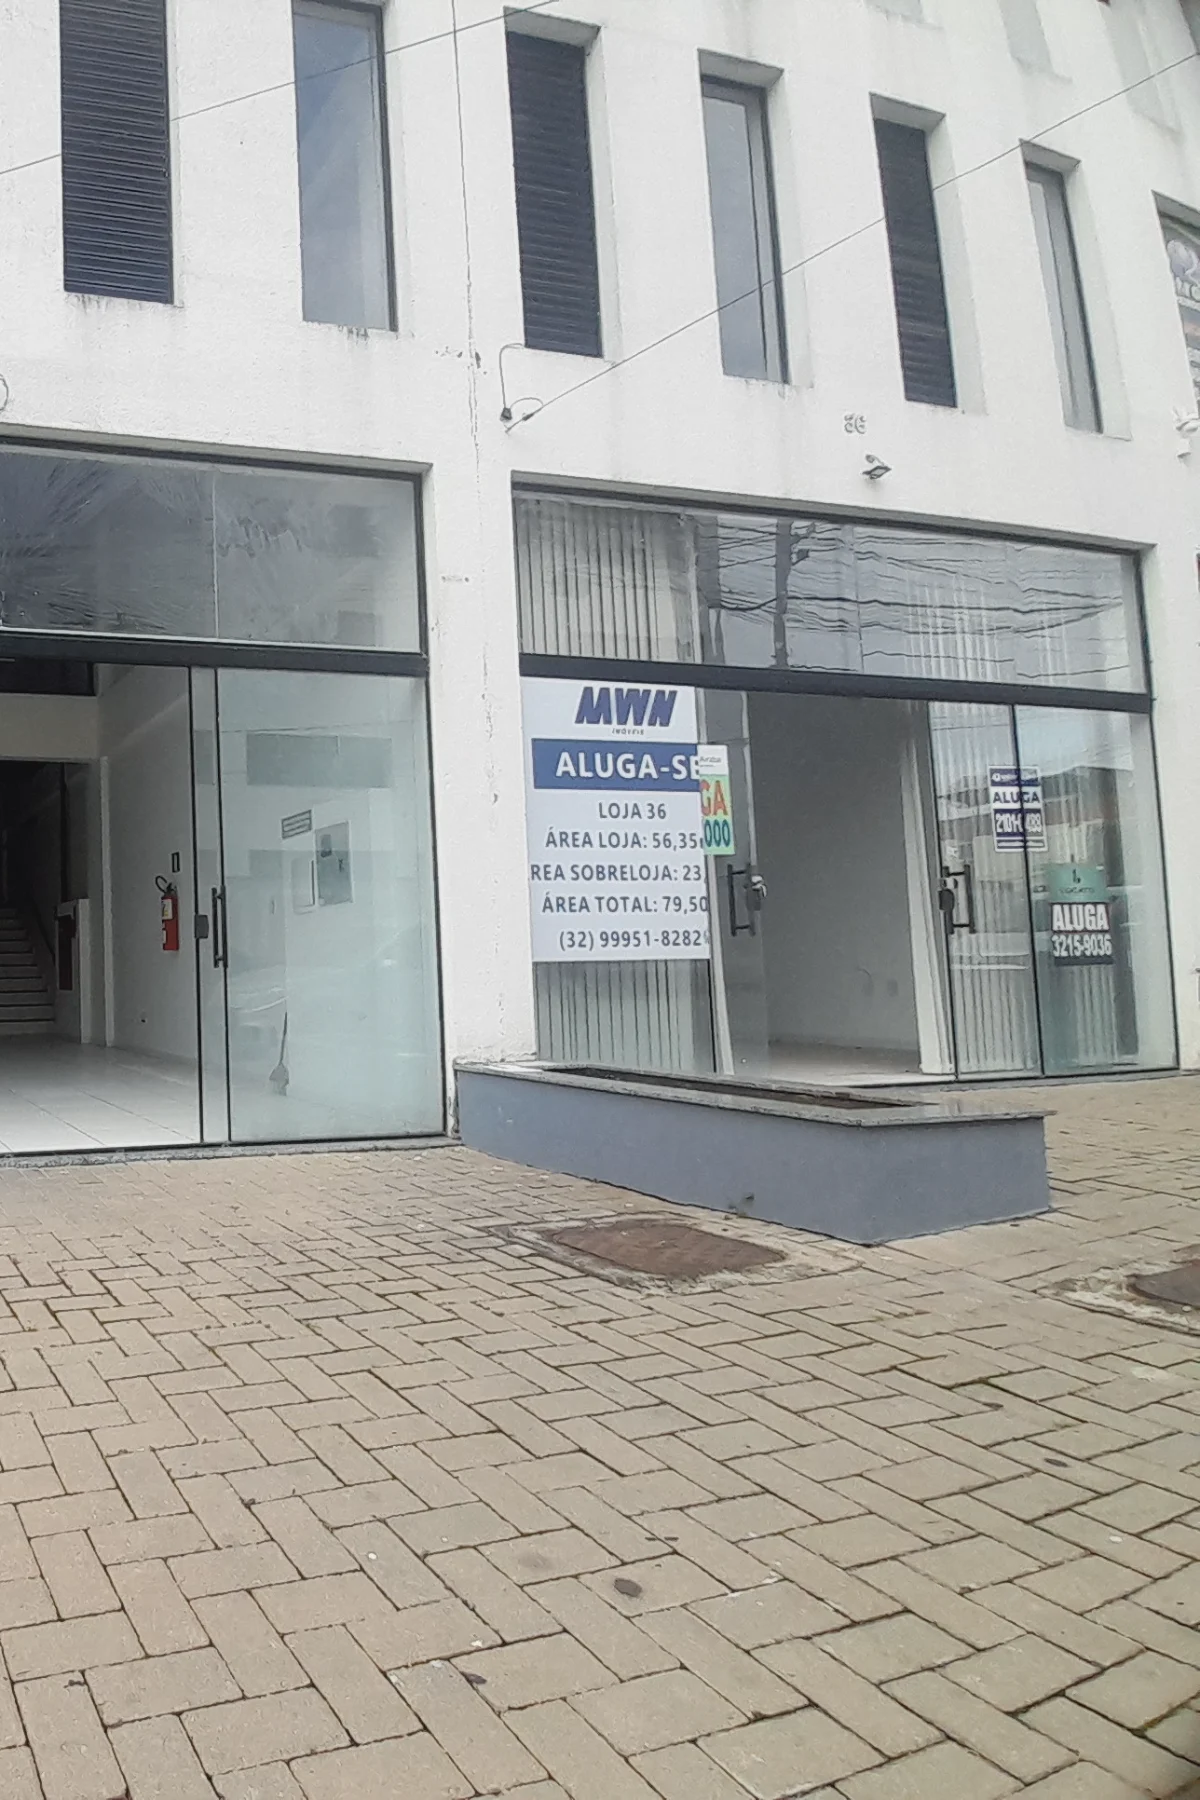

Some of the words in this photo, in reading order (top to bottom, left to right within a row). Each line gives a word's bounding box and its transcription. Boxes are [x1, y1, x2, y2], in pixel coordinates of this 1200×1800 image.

[574, 686, 678, 727] MWN
[993, 791, 1040, 803] ALUGA
[598, 802, 641, 819] LOJA
[647, 803, 667, 819] 36
[545, 827, 593, 848] ÁREA
[598, 832, 647, 848] LOJA:
[571, 865, 678, 881] SOBRELOJA:
[542, 892, 591, 913] ÁREA
[595, 896, 658, 913] TOTAL:
[1052, 904, 1109, 931] ALUGA
[559, 931, 595, 951] (32)
[599, 930, 702, 947] 99951-8282
